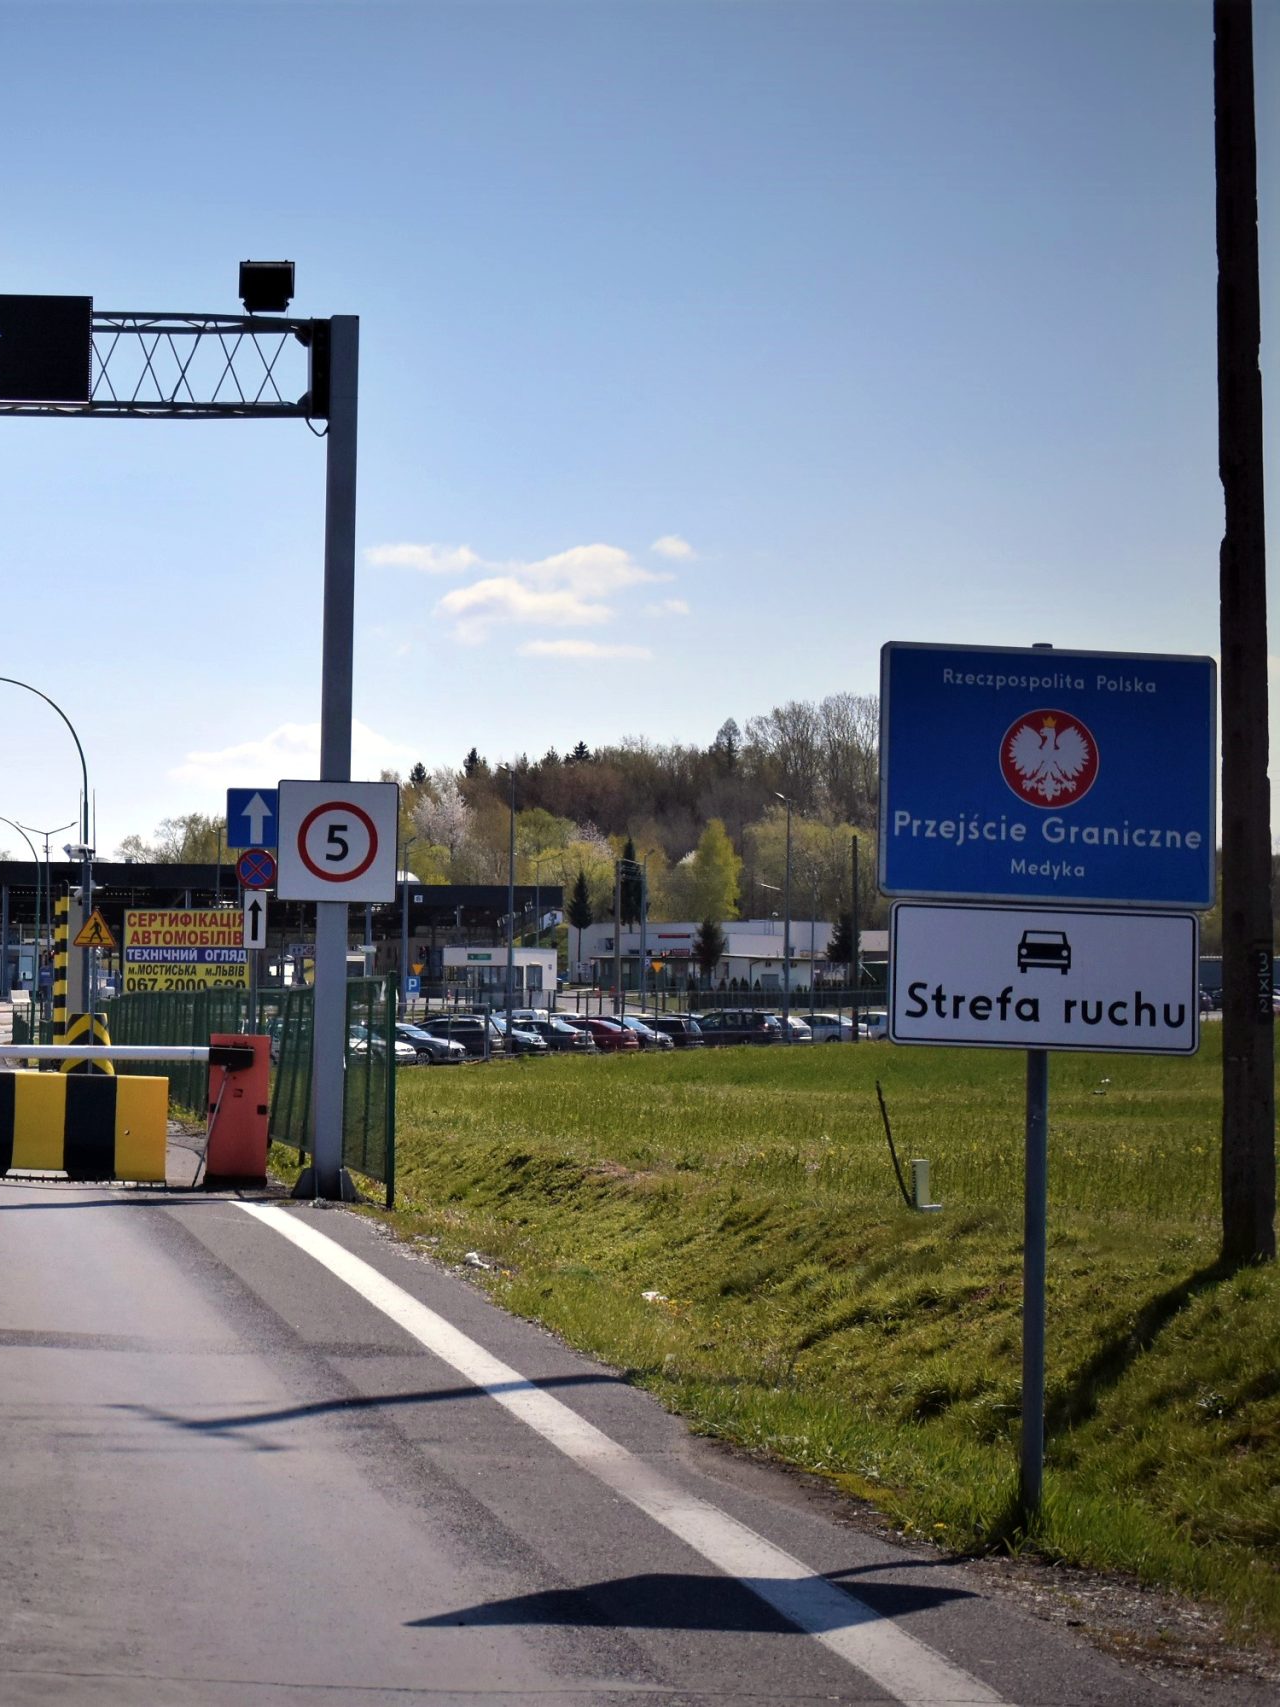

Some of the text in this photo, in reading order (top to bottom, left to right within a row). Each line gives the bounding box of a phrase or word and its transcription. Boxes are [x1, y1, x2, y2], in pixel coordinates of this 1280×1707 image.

[943, 668, 1157, 693] Rzeczpospolita Polska
[326, 824, 349, 861] 5
[894, 811, 1202, 849] Przejście Graniczne
[1010, 858, 1085, 881] Medyka
[127, 947, 247, 962] ТЕХНІЧНИЙ ОГЛЯД
[905, 982, 1185, 1028] Strefa ruchu
